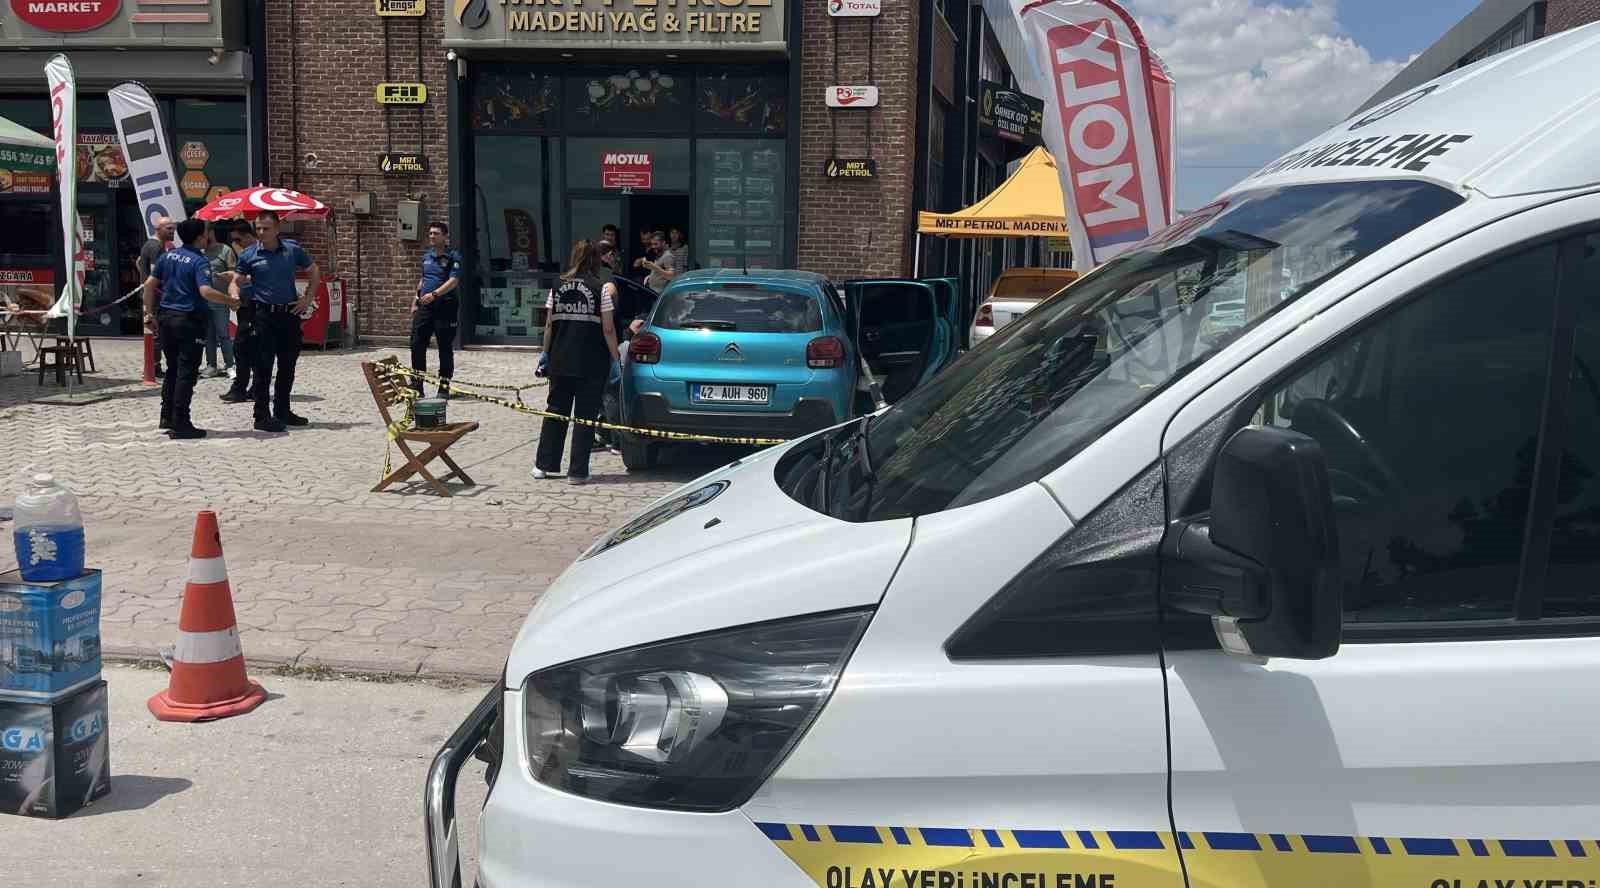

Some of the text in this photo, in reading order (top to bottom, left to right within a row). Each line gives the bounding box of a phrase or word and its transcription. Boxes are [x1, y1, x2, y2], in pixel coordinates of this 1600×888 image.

[28, 3, 102, 12] MARKET
[609, 8, 656, 32] YAĞ
[663, 12, 680, 32] &
[604, 154, 650, 165] MOTUL
[840, 169, 872, 177] PETROL
[935, 218, 961, 228] MRT
[964, 219, 1010, 230] PETROL
[701, 387, 767, 399] 42 AUH 960
[826, 865, 895, 888] OLAY
